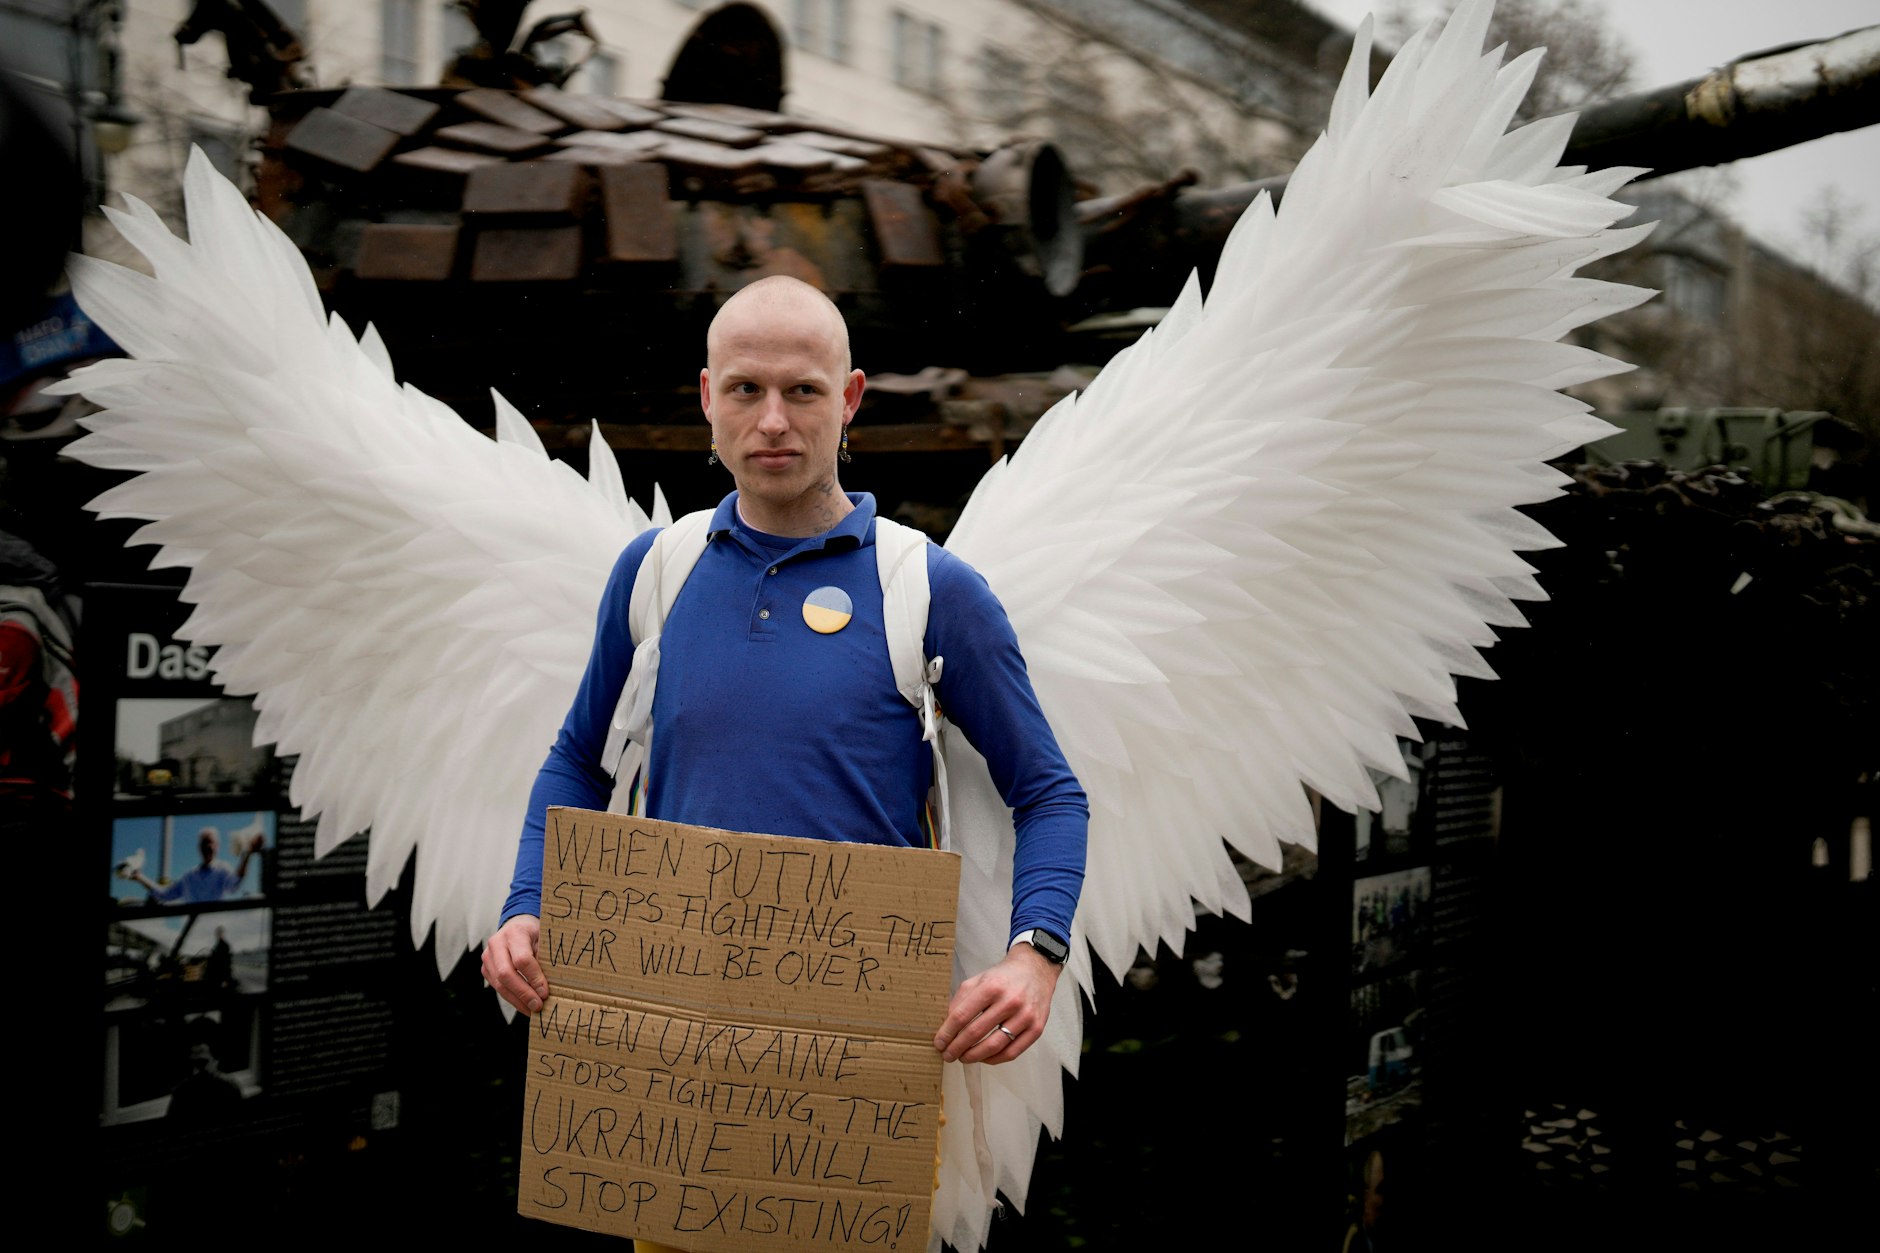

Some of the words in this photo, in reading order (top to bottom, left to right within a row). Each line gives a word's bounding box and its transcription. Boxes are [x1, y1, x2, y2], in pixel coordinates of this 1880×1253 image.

[126, 632, 210, 681] Das
[554, 817, 684, 877] WHEN
[705, 842, 851, 905] PUTIN
[547, 881, 663, 925] STOPS
[880, 915, 954, 957] THE
[548, 929, 617, 974] WAR
[639, 937, 710, 977] WILL
[722, 943, 770, 981] BE
[775, 950, 886, 993] OVER.
[539, 1003, 647, 1053] WHEN
[659, 1017, 875, 1082] UKRAINE
[531, 1090, 748, 1177] UKRAINE
[772, 1133, 892, 1185] WILL
[535, 1054, 628, 1093] STOPS
[838, 1097, 925, 1140] THE
[533, 1166, 657, 1222] STOP
[674, 1184, 912, 1250] EXISTING!
